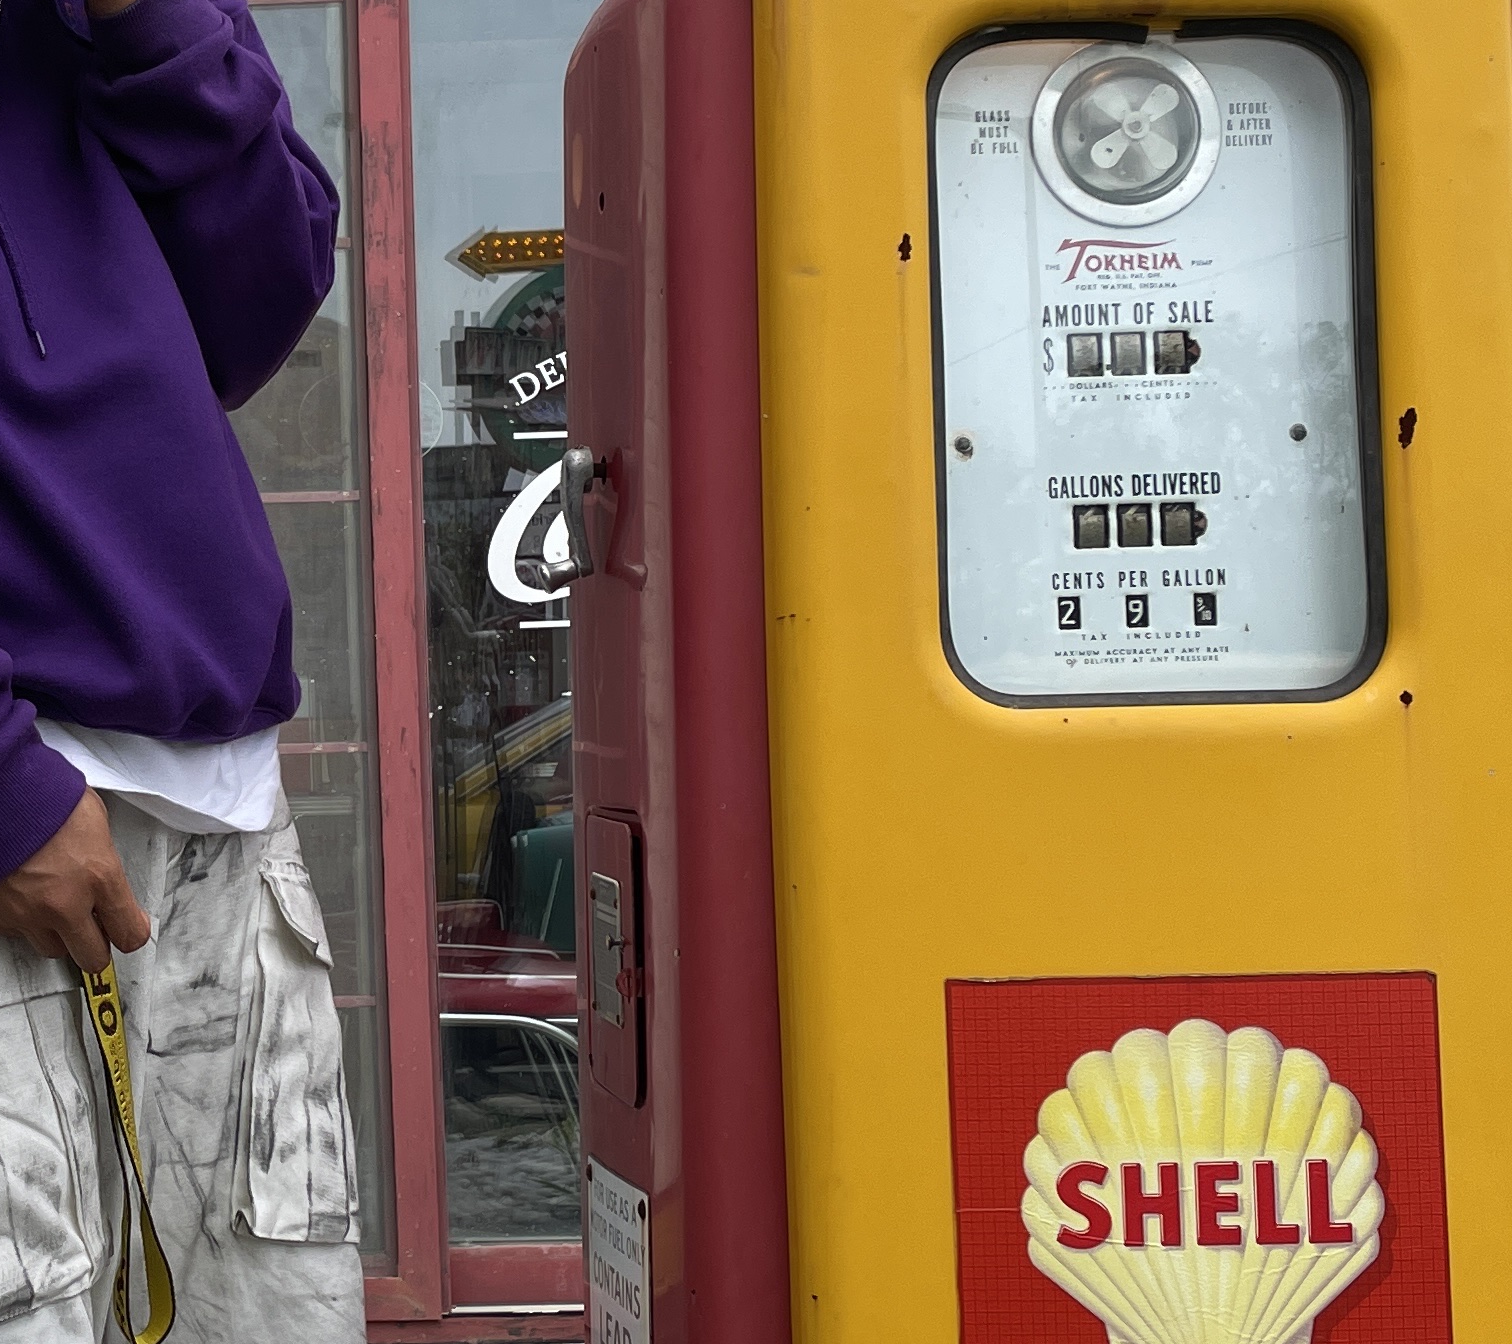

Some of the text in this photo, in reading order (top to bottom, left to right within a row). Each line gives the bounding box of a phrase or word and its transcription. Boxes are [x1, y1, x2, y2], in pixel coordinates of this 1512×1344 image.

[1228, 102, 1268, 115] BEFORE
[974, 109, 1011, 123] GLASS
[978, 125, 1009, 138] MUST
[1226, 118, 1271, 131] & AFTER
[1225, 134, 1273, 147] DELIVERY
[970, 141, 1019, 155] BE FULL
[1055, 238, 1184, 284] TOKHEIM
[1042, 299, 1215, 328] AMOUNT OF SALE
[1043, 337, 1055, 376] $
[1069, 380, 1175, 390] DOLLARS CENTS
[1071, 392, 1191, 402] TAX INCLUDED
[1048, 472, 1222, 499] GALLONS DELIVERED
[1051, 568, 1227, 591] CENTS PER GALLON
[1059, 599, 1077, 625] 2
[1128, 599, 1144, 625] 9
[1081, 631, 1202, 641] TAX INCLUDED
[1106, 648, 1158, 656] ACCURACY
[1181, 646, 1201, 654] ANY
[1174, 654, 1220, 663] PRESSURE
[594, 1176, 638, 1229] FOR USE AS A
[1055, 1158, 1354, 1250] SHELL
[608, 1222, 626, 1255] FUEL
[626, 1229, 646, 1269] ONLY
[593, 1250, 642, 1321] CONTAINS
